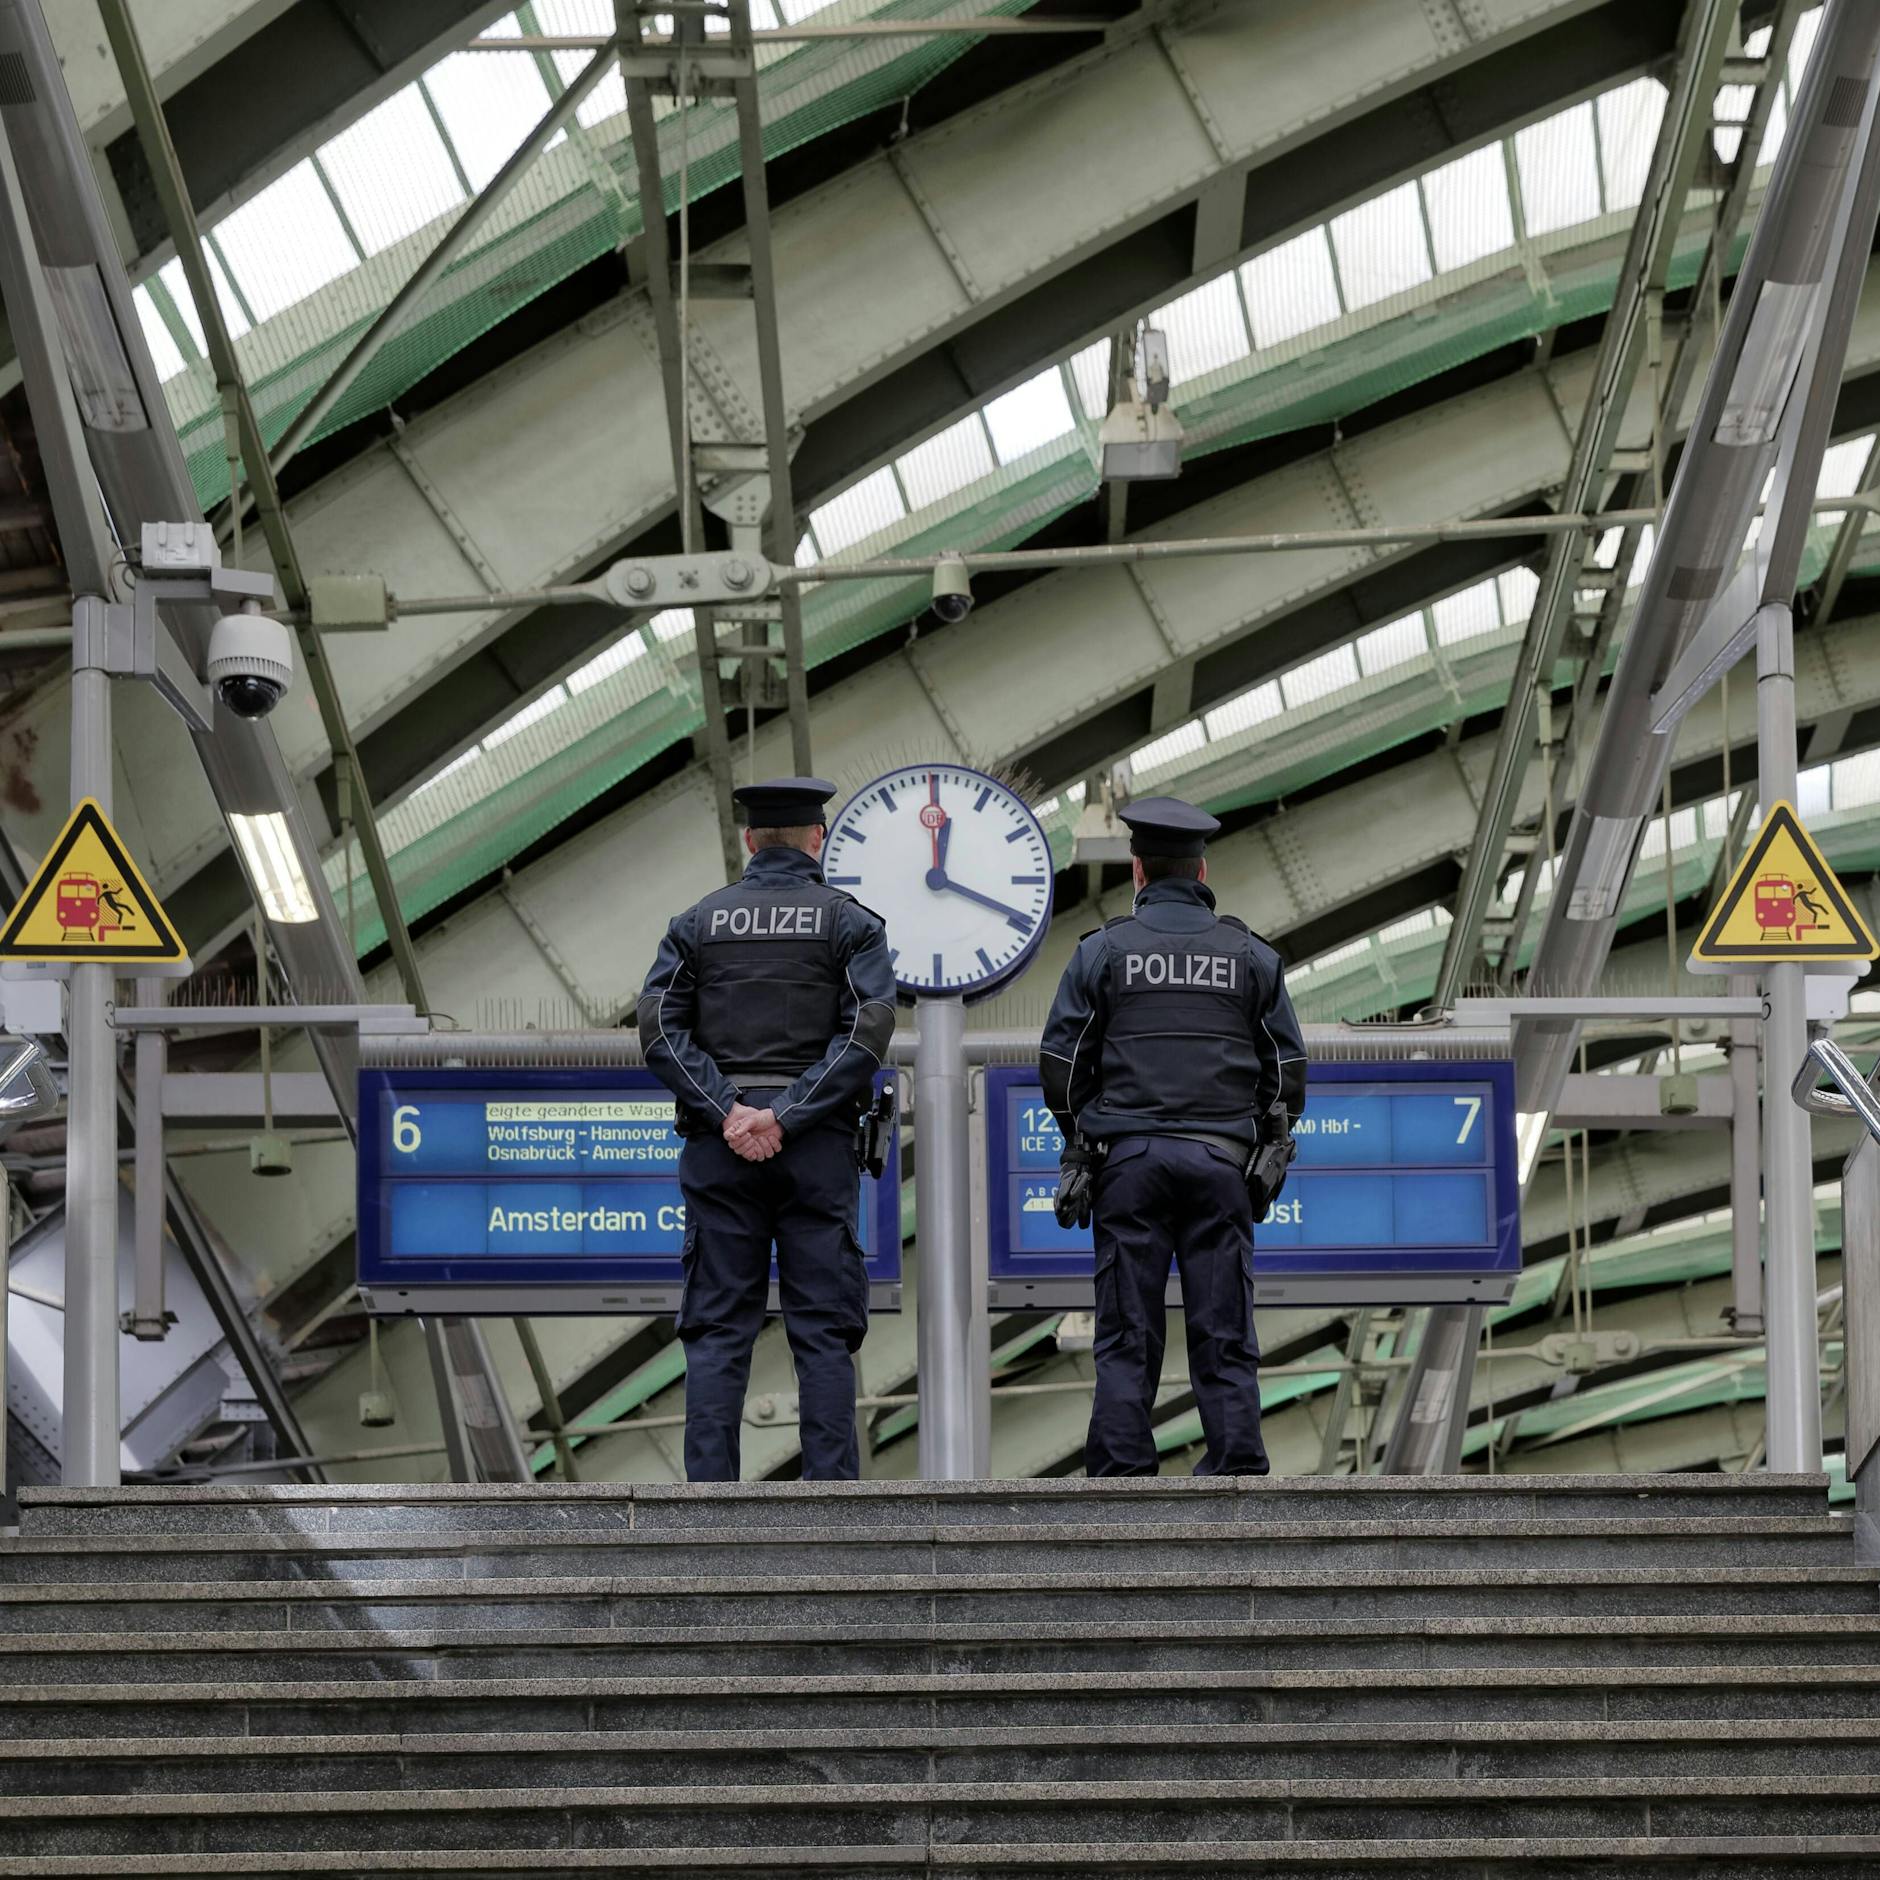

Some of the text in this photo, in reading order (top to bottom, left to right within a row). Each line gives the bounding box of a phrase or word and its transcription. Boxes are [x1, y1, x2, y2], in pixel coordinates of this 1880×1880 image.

[711, 906, 822, 936] POLIZEI
[1126, 953, 1236, 989] POLIZEI
[392, 1105, 422, 1152] 6
[1321, 1119, 1349, 1134] Hbf
[1453, 1097, 1481, 1144] 7
[488, 1126, 575, 1144] Wolfsburg
[591, 1126, 668, 1141] Hannover
[1021, 1136, 1065, 1151] ICE 3
[488, 1145, 576, 1161] Osnabrück
[1025, 1187, 1035, 1197] A
[488, 1206, 646, 1232] Amsterdam
